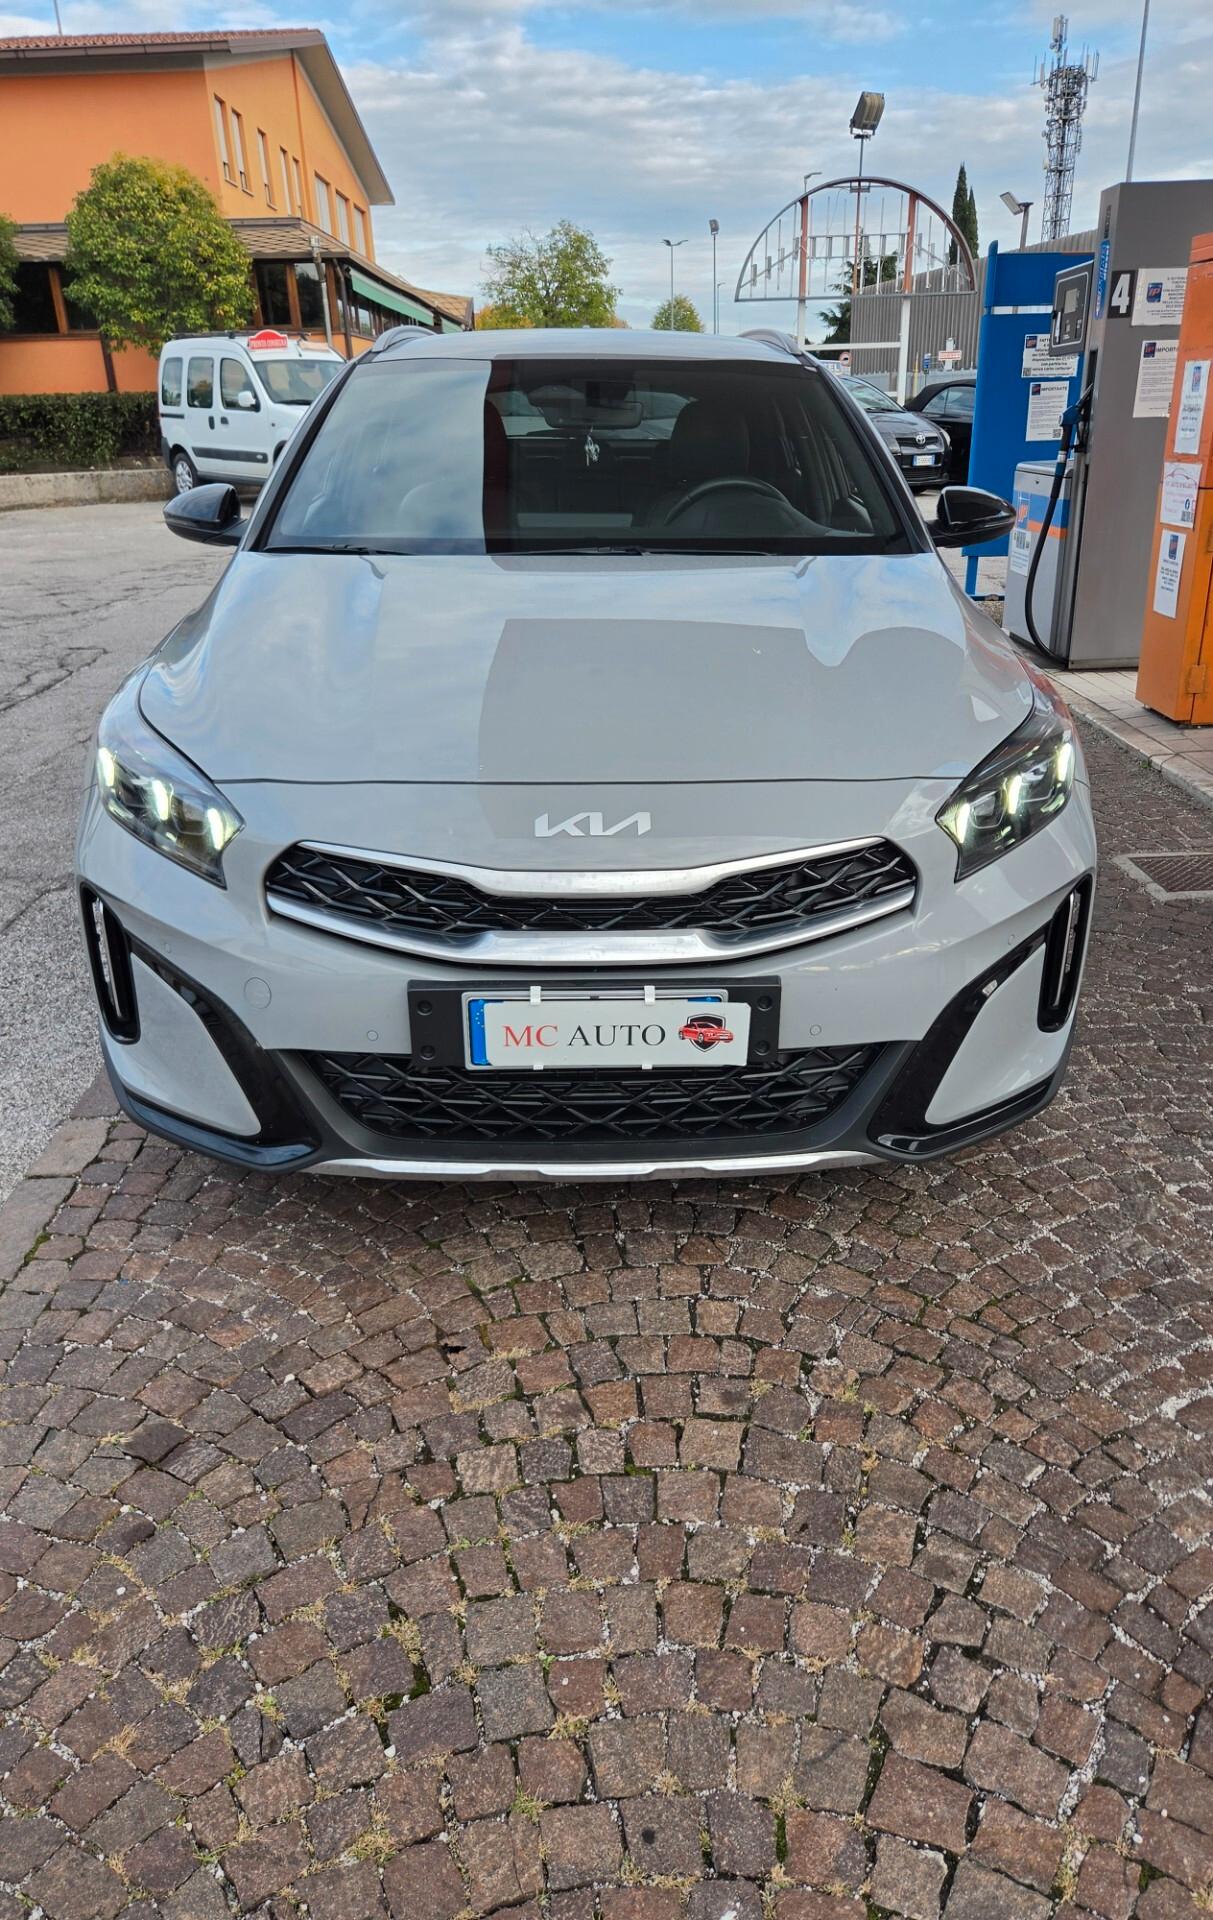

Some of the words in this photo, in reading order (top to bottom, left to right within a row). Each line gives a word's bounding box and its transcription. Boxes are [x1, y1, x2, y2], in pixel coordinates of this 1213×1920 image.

[1111, 273, 1131, 314] 4
[535, 811, 651, 837] KIA
[502, 1024, 558, 1047] MC
[567, 1024, 666, 1047] AUTO
